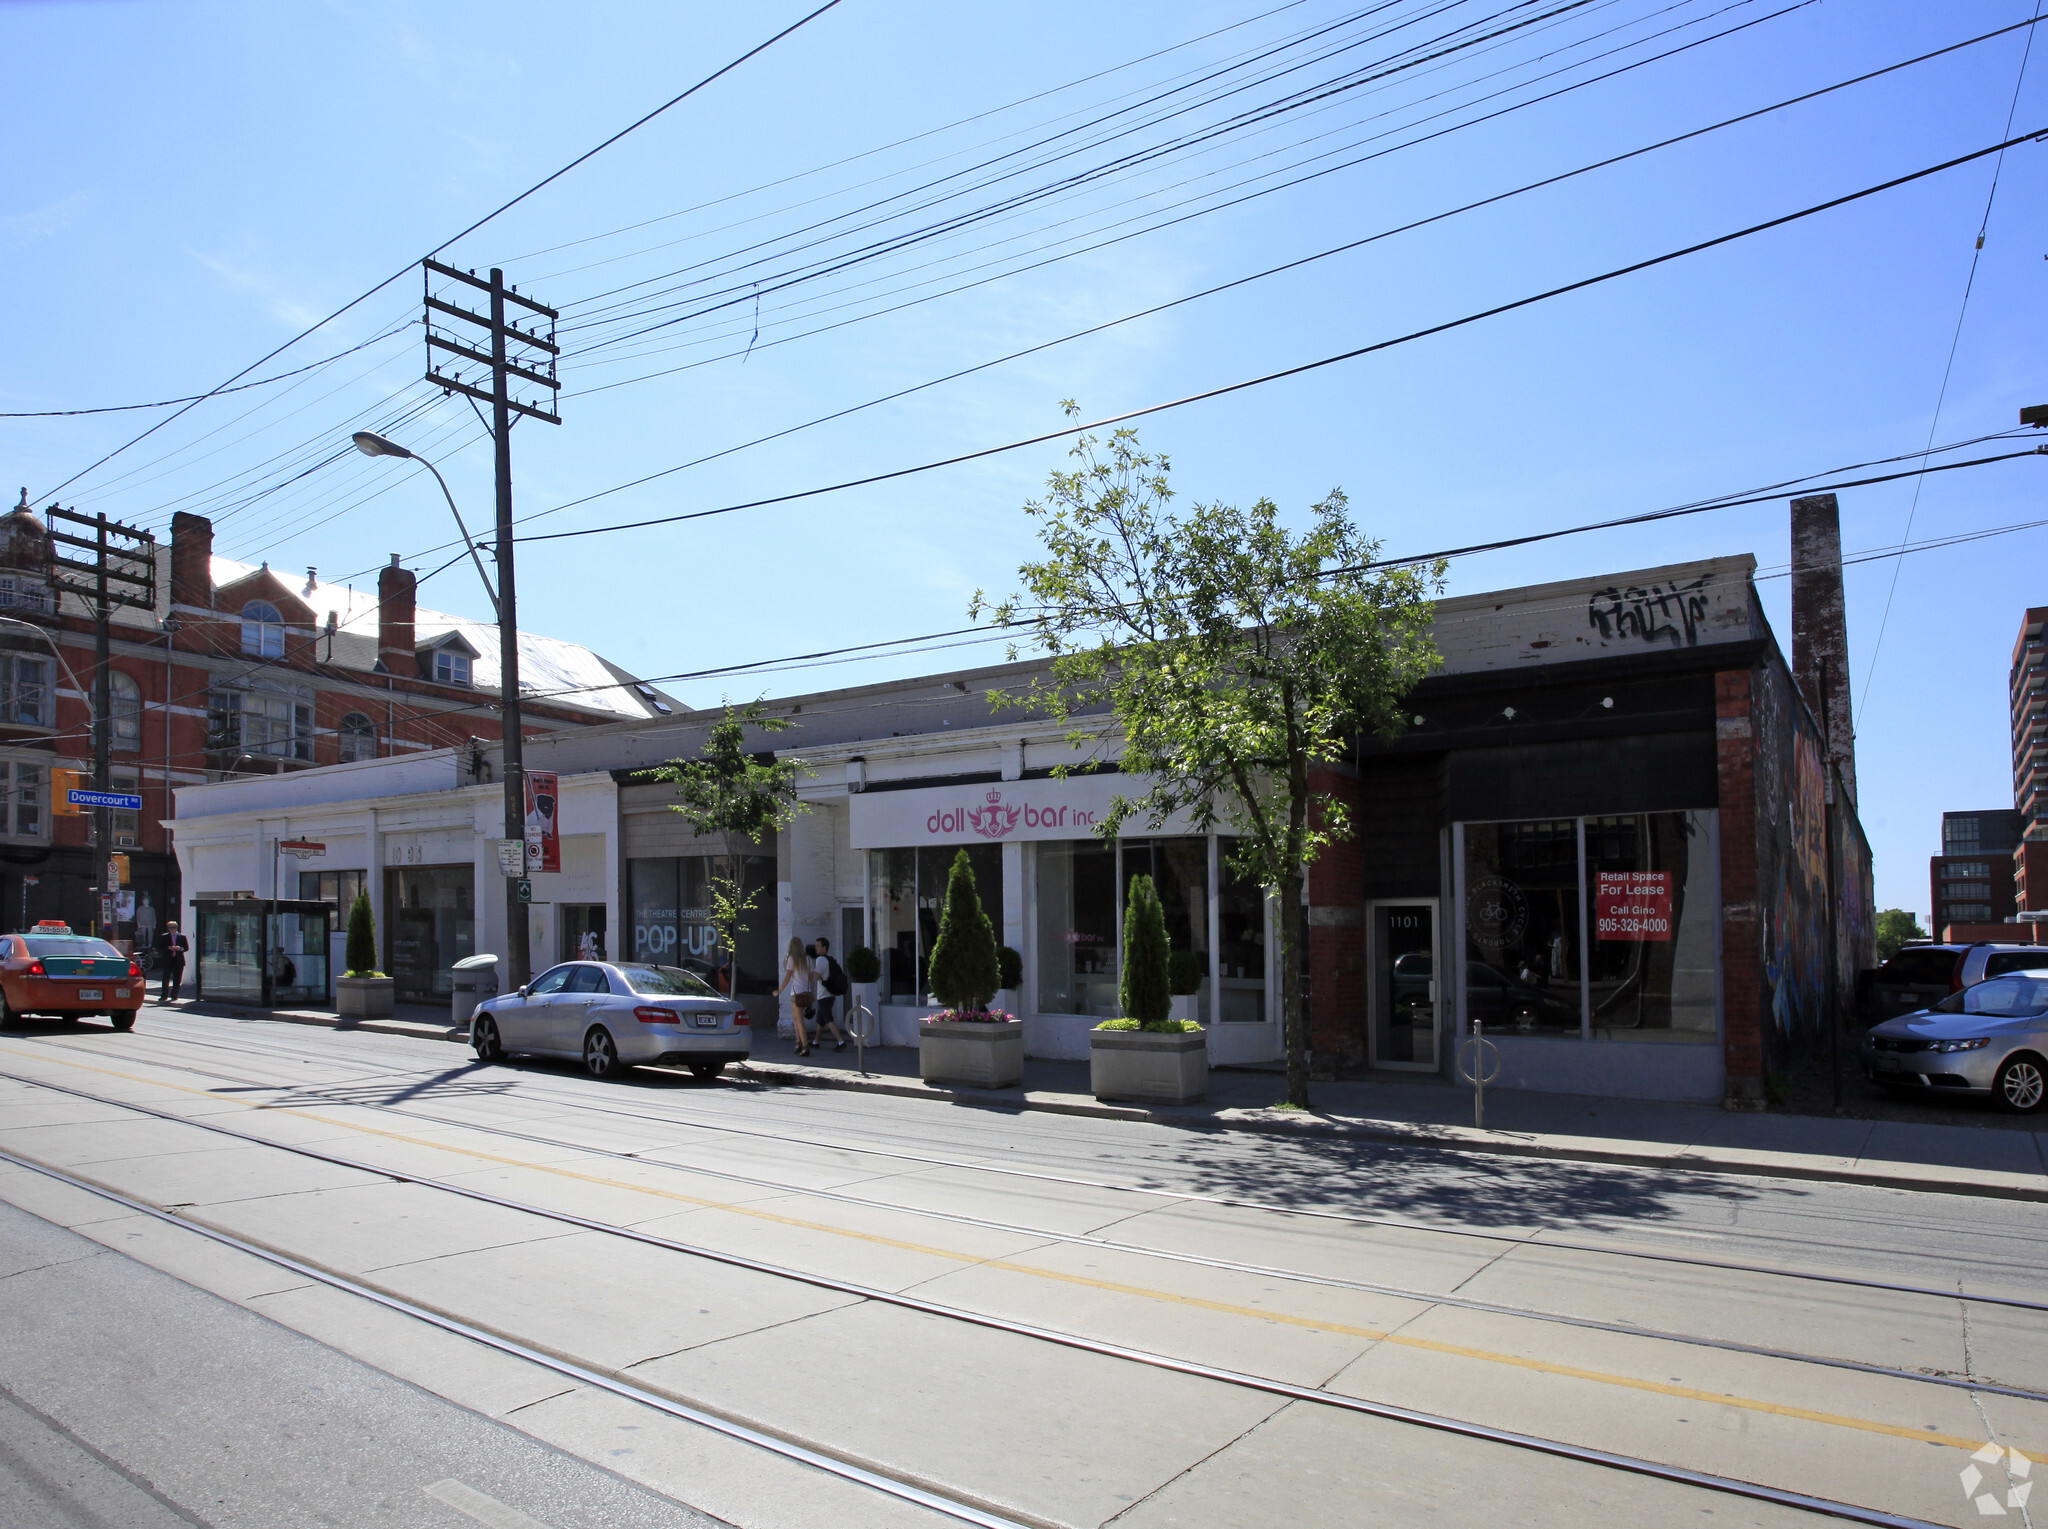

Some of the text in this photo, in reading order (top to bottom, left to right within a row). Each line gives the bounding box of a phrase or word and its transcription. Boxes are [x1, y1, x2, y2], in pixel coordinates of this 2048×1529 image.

[71, 791, 129, 806] Dovercourt
[927, 807, 965, 833] doll
[1024, 802, 1068, 828] bar
[1600, 872, 1665, 883] Retail Space
[1471, 880, 1522, 902] BLACKSMITH
[1600, 884, 1665, 895] For Lease
[636, 909, 707, 918] THE THEATRE CENTRE
[1610, 905, 1656, 914] Call Gino
[1390, 916, 1418, 928] 1101
[1513, 906, 1526, 935] CYCLE
[1599, 918, 1668, 932] 905-326-4000
[635, 925, 718, 956] POP-UP
